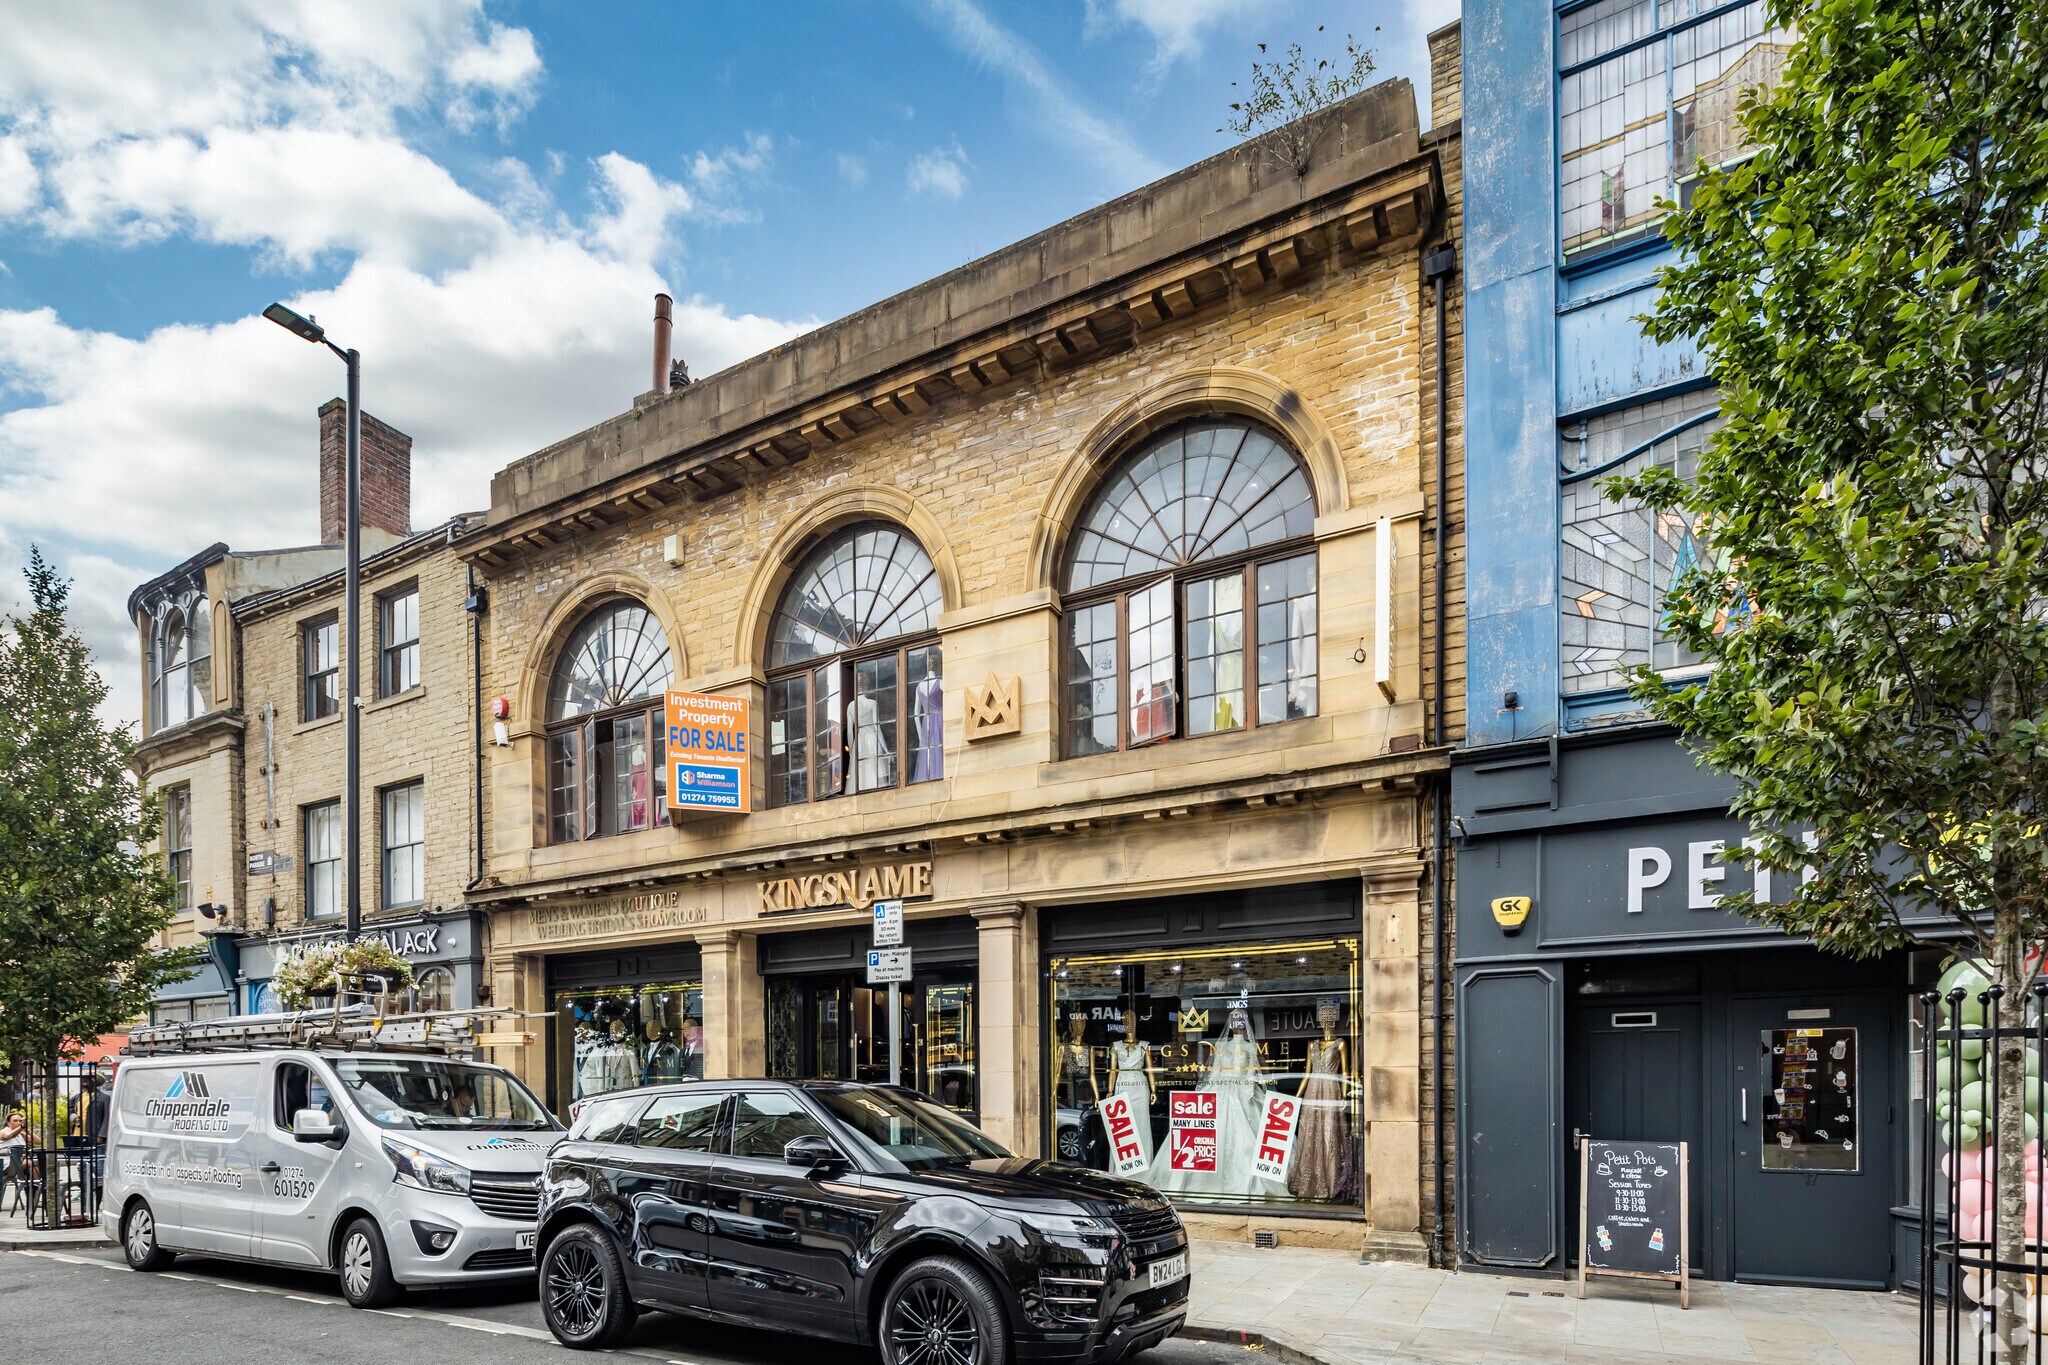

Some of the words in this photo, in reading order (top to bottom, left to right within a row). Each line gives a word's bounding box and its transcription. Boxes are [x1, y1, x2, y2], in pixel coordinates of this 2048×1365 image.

[670, 693, 743, 712] Investment
[679, 709, 735, 728] Property
[669, 726, 700, 749] FOR
[705, 730, 745, 752] SALE
[670, 752, 692, 760] Existing
[716, 755, 746, 763] Unaffected
[696, 772, 725, 780] Sharma
[696, 780, 736, 788] Williamson
[682, 793, 706, 802] 01274
[708, 795, 736, 804] 759955
[756, 862, 934, 910] KINGSNAME
[622, 892, 678, 914] BOUTIQUE
[1500, 900, 1521, 911] GK
[871, 954, 878, 965] P
[145, 1099, 230, 1120] Chippendale
[1174, 1095, 1214, 1115] sale
[174, 1120, 210, 1130] ROOFING
[213, 1120, 228, 1131] LTD
[1173, 1119, 1191, 1128] MANY
[1194, 1120, 1215, 1128] LINES
[1105, 1100, 1140, 1162] SALE
[1259, 1098, 1294, 1164] SALE
[1194, 1146, 1215, 1158] PRICE
[1604, 1150, 1631, 1165] Petit
[1634, 1150, 1656, 1165] Pois
[1121, 1162, 1133, 1171] NOW
[1135, 1159, 1144, 1167] ON
[1256, 1163, 1270, 1172] NOW
[1272, 1167, 1281, 1176] ON
[125, 1161, 157, 1178] Specialists
[158, 1164, 164, 1177] in
[166, 1164, 175, 1177] all
[176, 1166, 202, 1184] aspects
[204, 1168, 212, 1182] of
[213, 1169, 242, 1188] Roofing
[284, 1166, 304, 1178] 01274
[274, 1178, 315, 1198] 601529
[1608, 1179, 1632, 1188] Session
